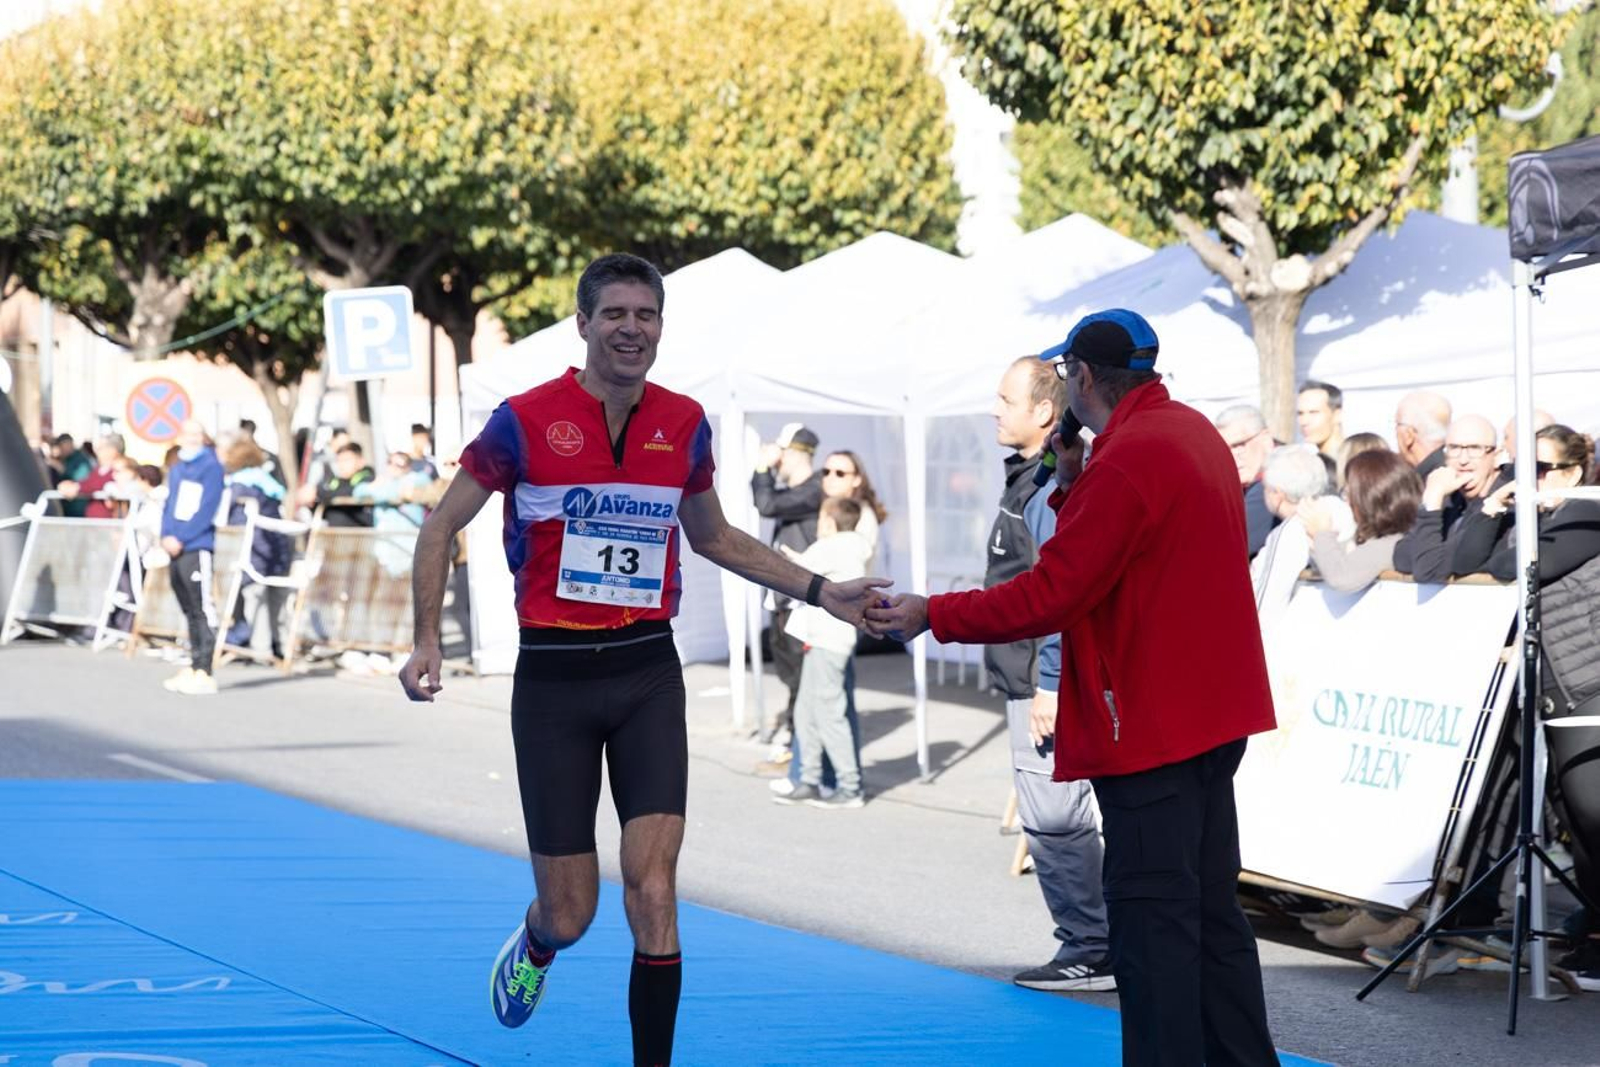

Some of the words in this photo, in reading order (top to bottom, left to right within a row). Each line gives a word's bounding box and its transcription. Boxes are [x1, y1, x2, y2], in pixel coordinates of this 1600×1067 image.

[342, 299, 397, 370] P
[597, 495, 673, 518] Avanza
[597, 545, 640, 575] 13
[1378, 696, 1464, 747] RURAL
[1341, 740, 1411, 790] JAÉN
